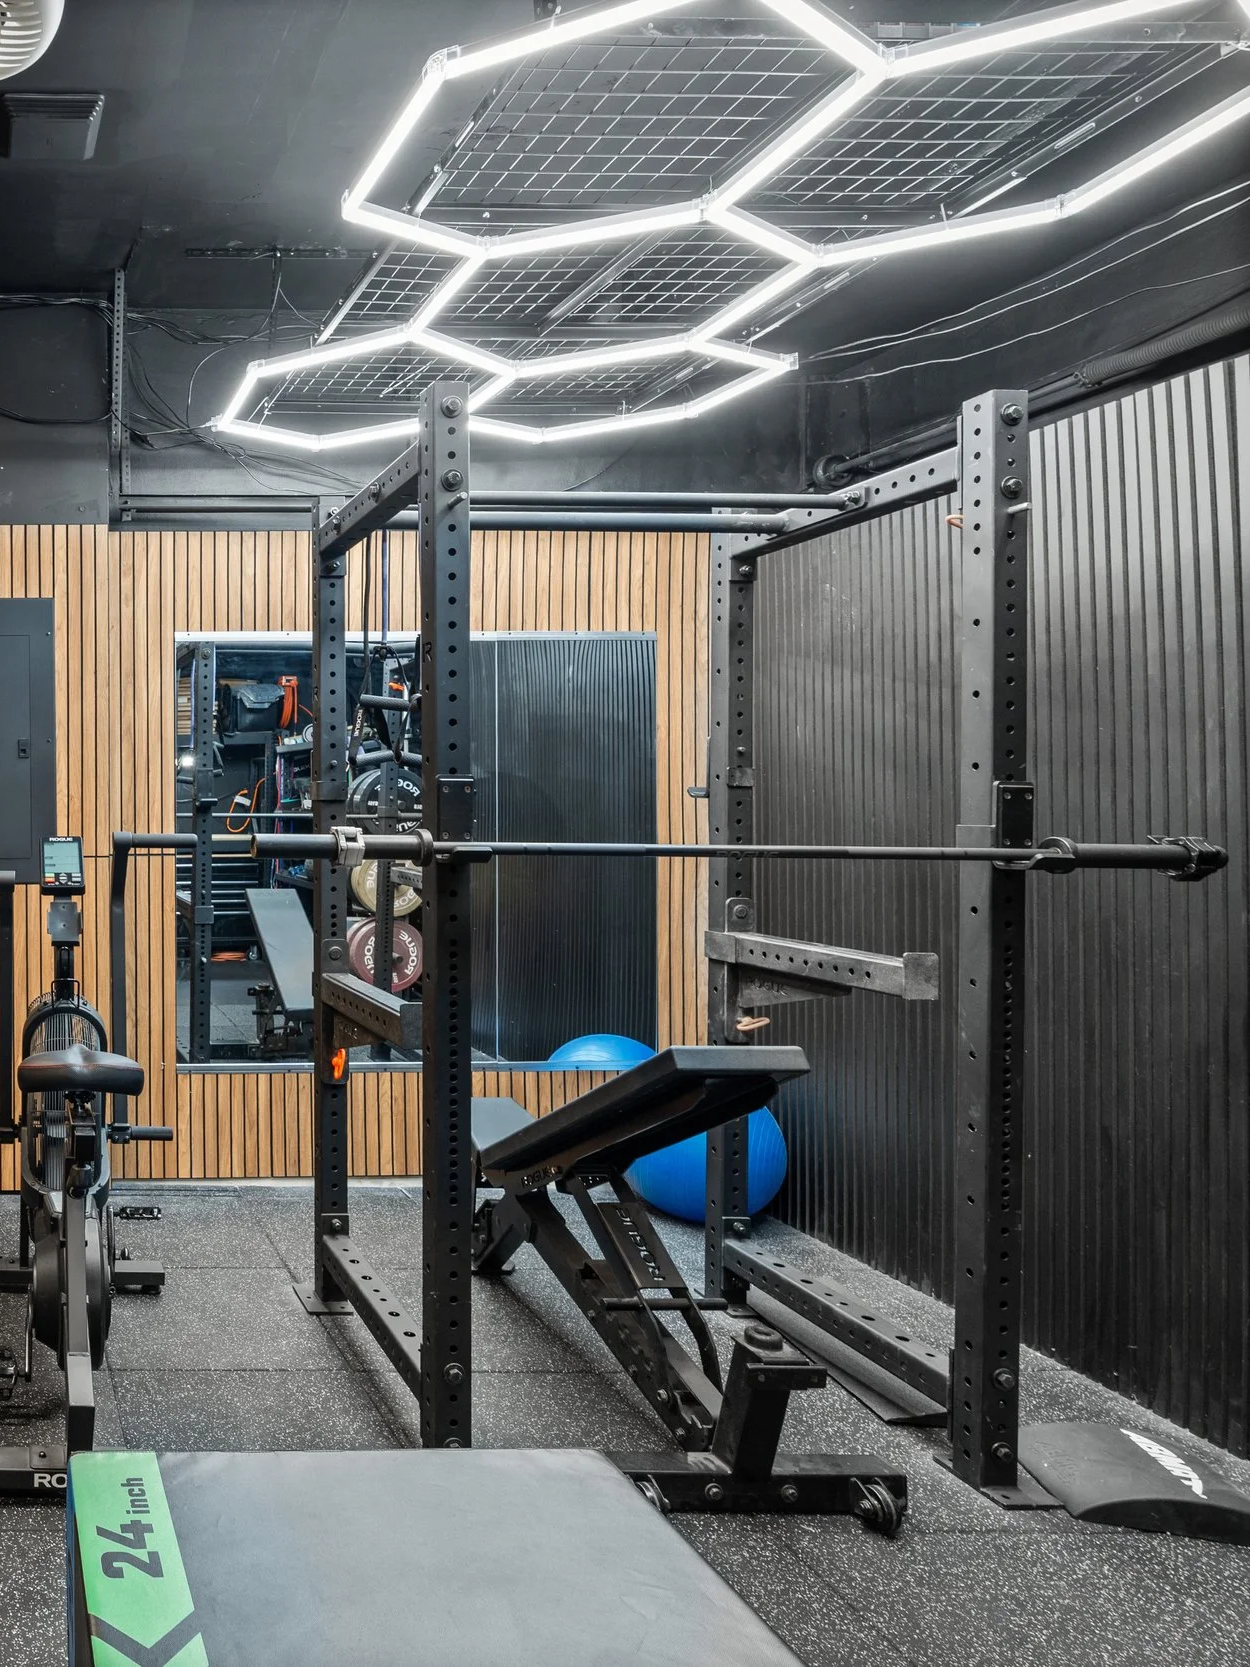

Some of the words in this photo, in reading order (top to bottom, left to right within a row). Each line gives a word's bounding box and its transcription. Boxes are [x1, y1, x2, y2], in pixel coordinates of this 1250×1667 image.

[616, 1207, 666, 1281] ROGUE
[33, 1473, 68, 1489] RO
[120, 1477, 151, 1515] inch
[96, 1519, 165, 1579] 24
